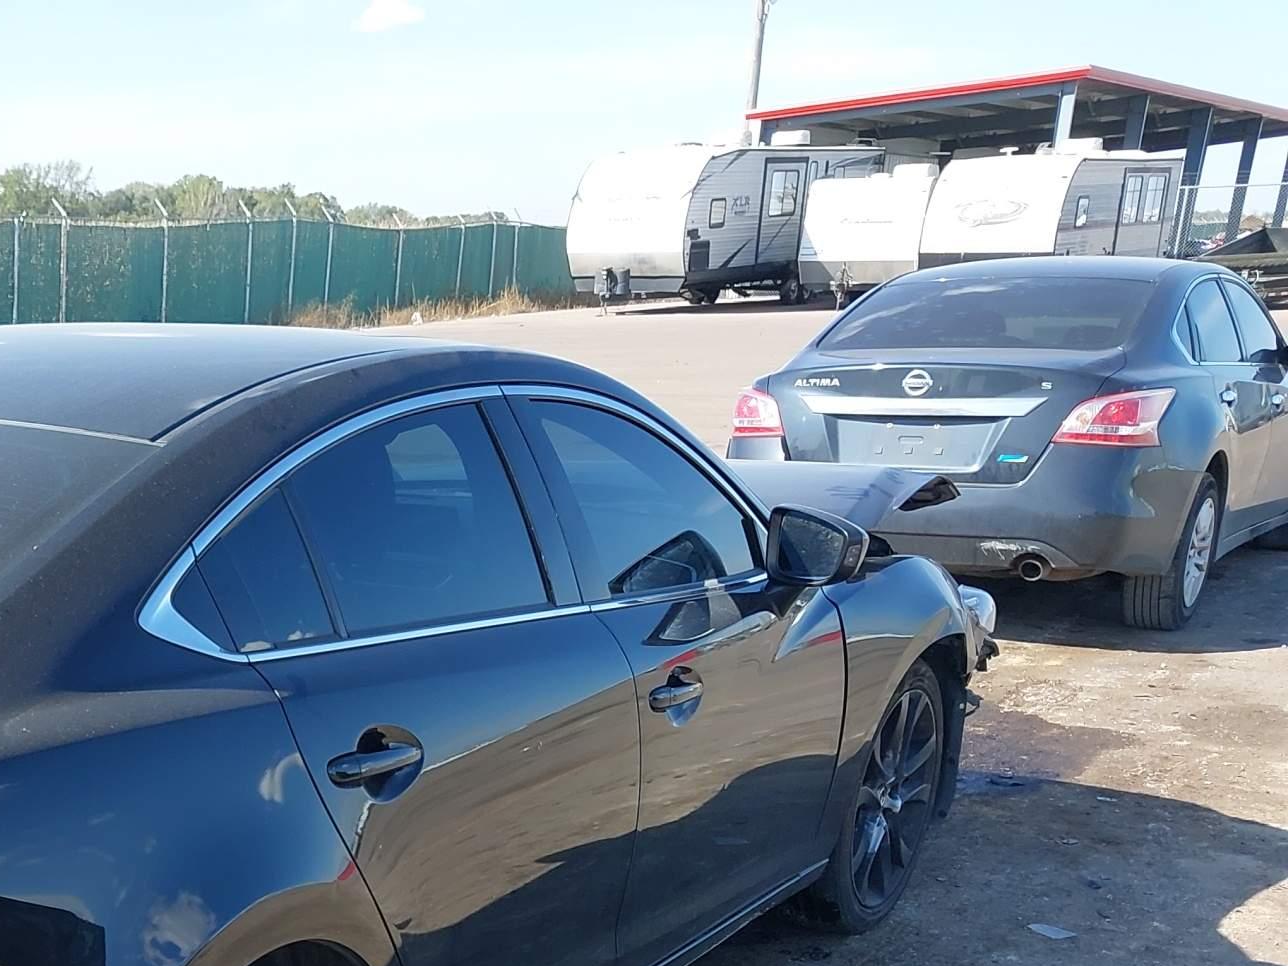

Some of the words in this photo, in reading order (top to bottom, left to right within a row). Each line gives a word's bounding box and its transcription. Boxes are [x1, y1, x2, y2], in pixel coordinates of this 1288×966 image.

[730, 197, 751, 211] XLR
[794, 378, 840, 388] ALTIMA
[1040, 381, 1053, 390] S
